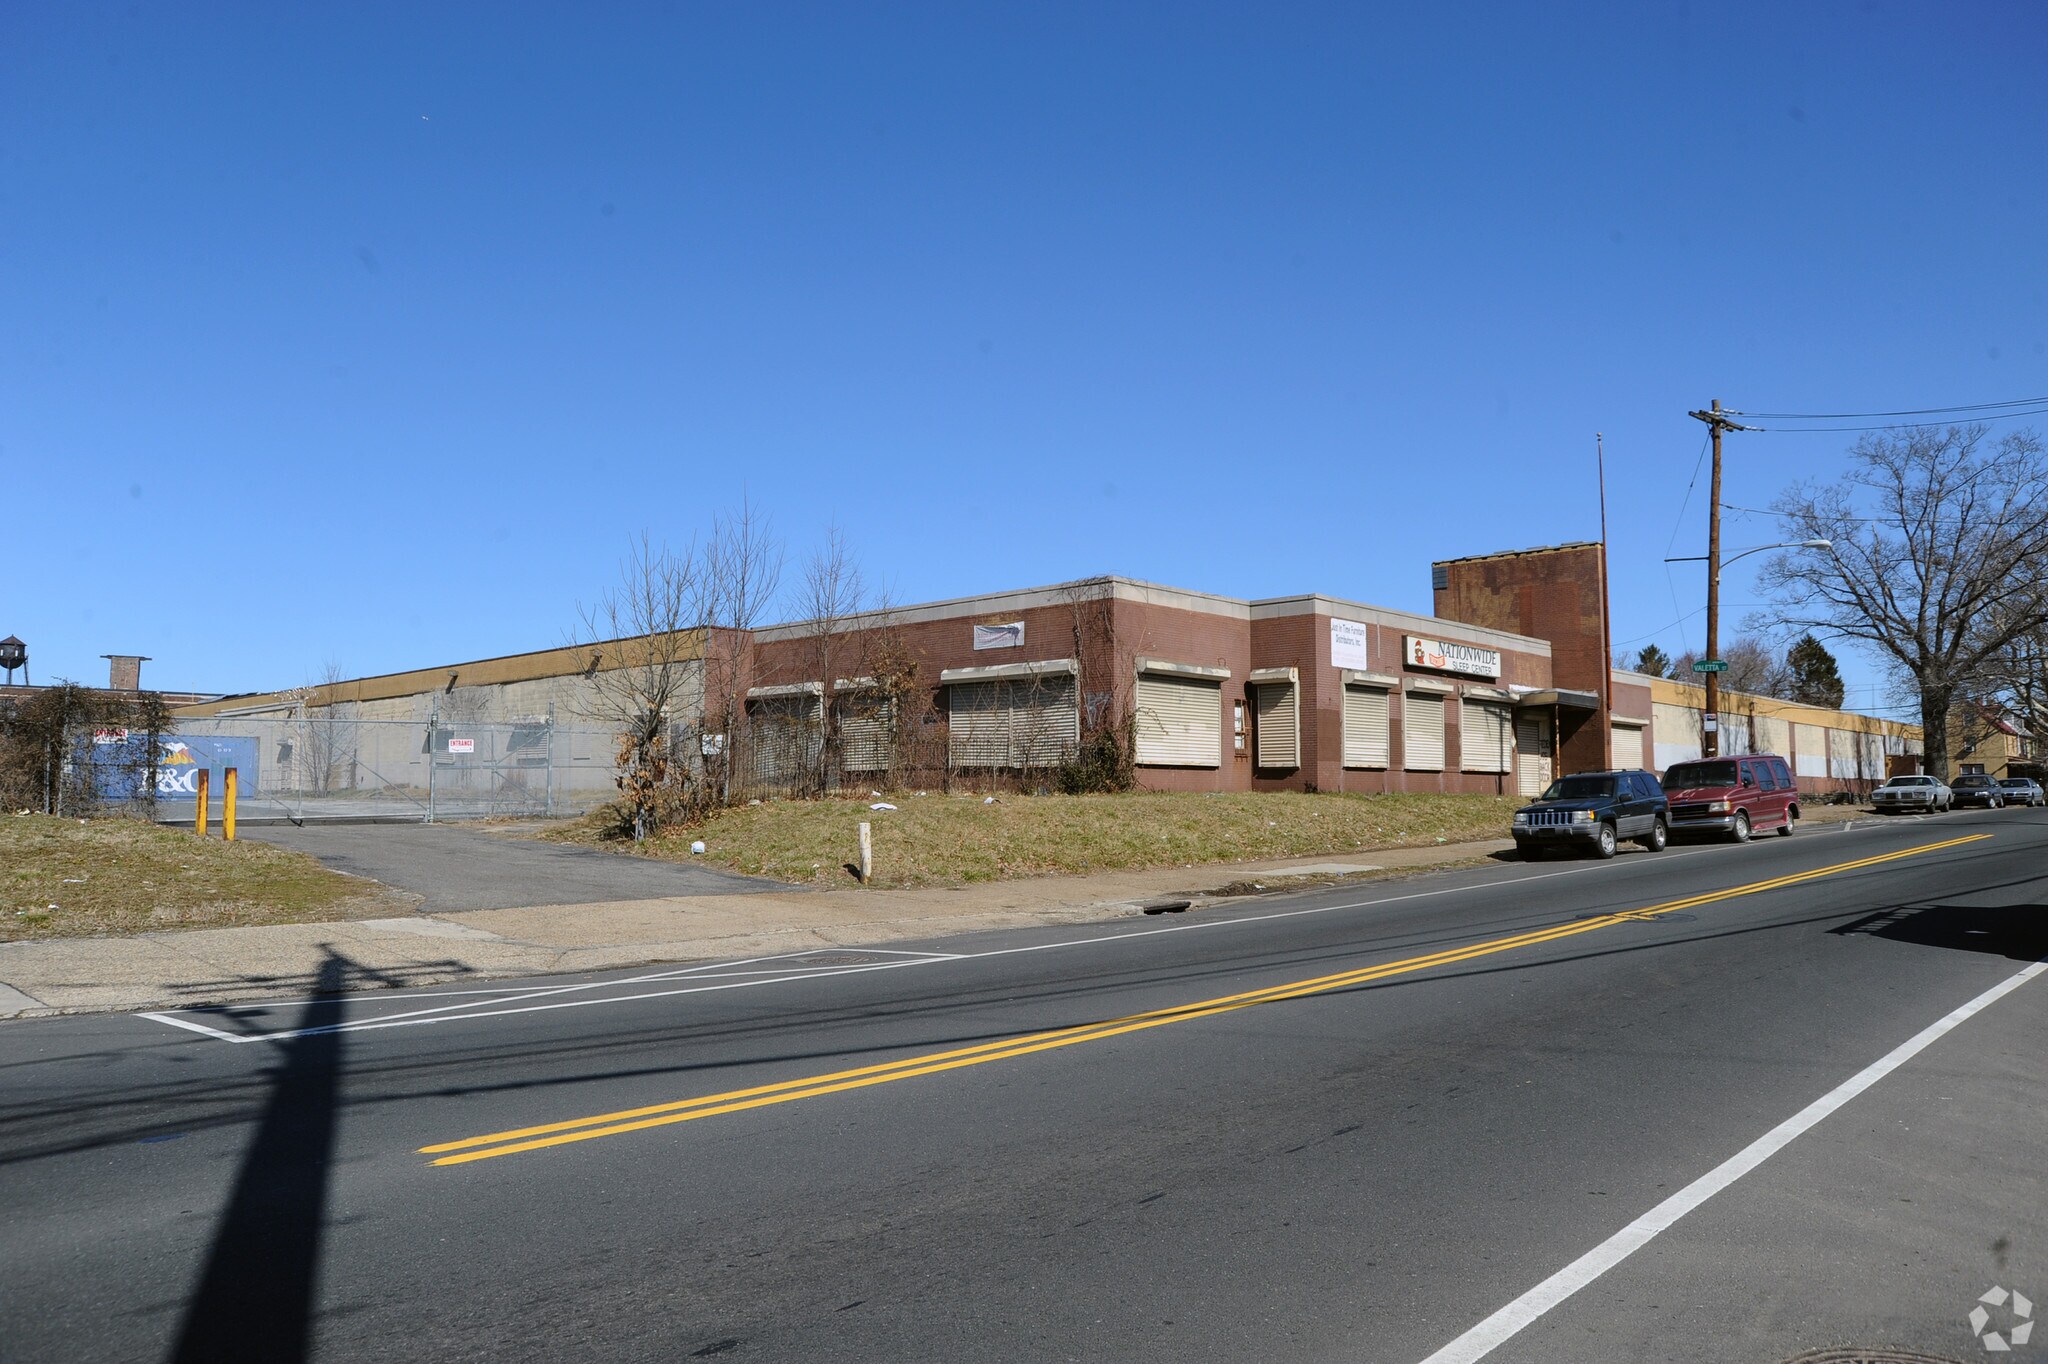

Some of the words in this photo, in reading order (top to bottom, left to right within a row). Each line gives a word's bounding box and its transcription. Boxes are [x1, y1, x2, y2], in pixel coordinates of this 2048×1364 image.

[1438, 641, 1497, 665] NATIONWIDE
[1452, 661, 1469, 672] SLEEP
[1471, 664, 1492, 675] CENTER
